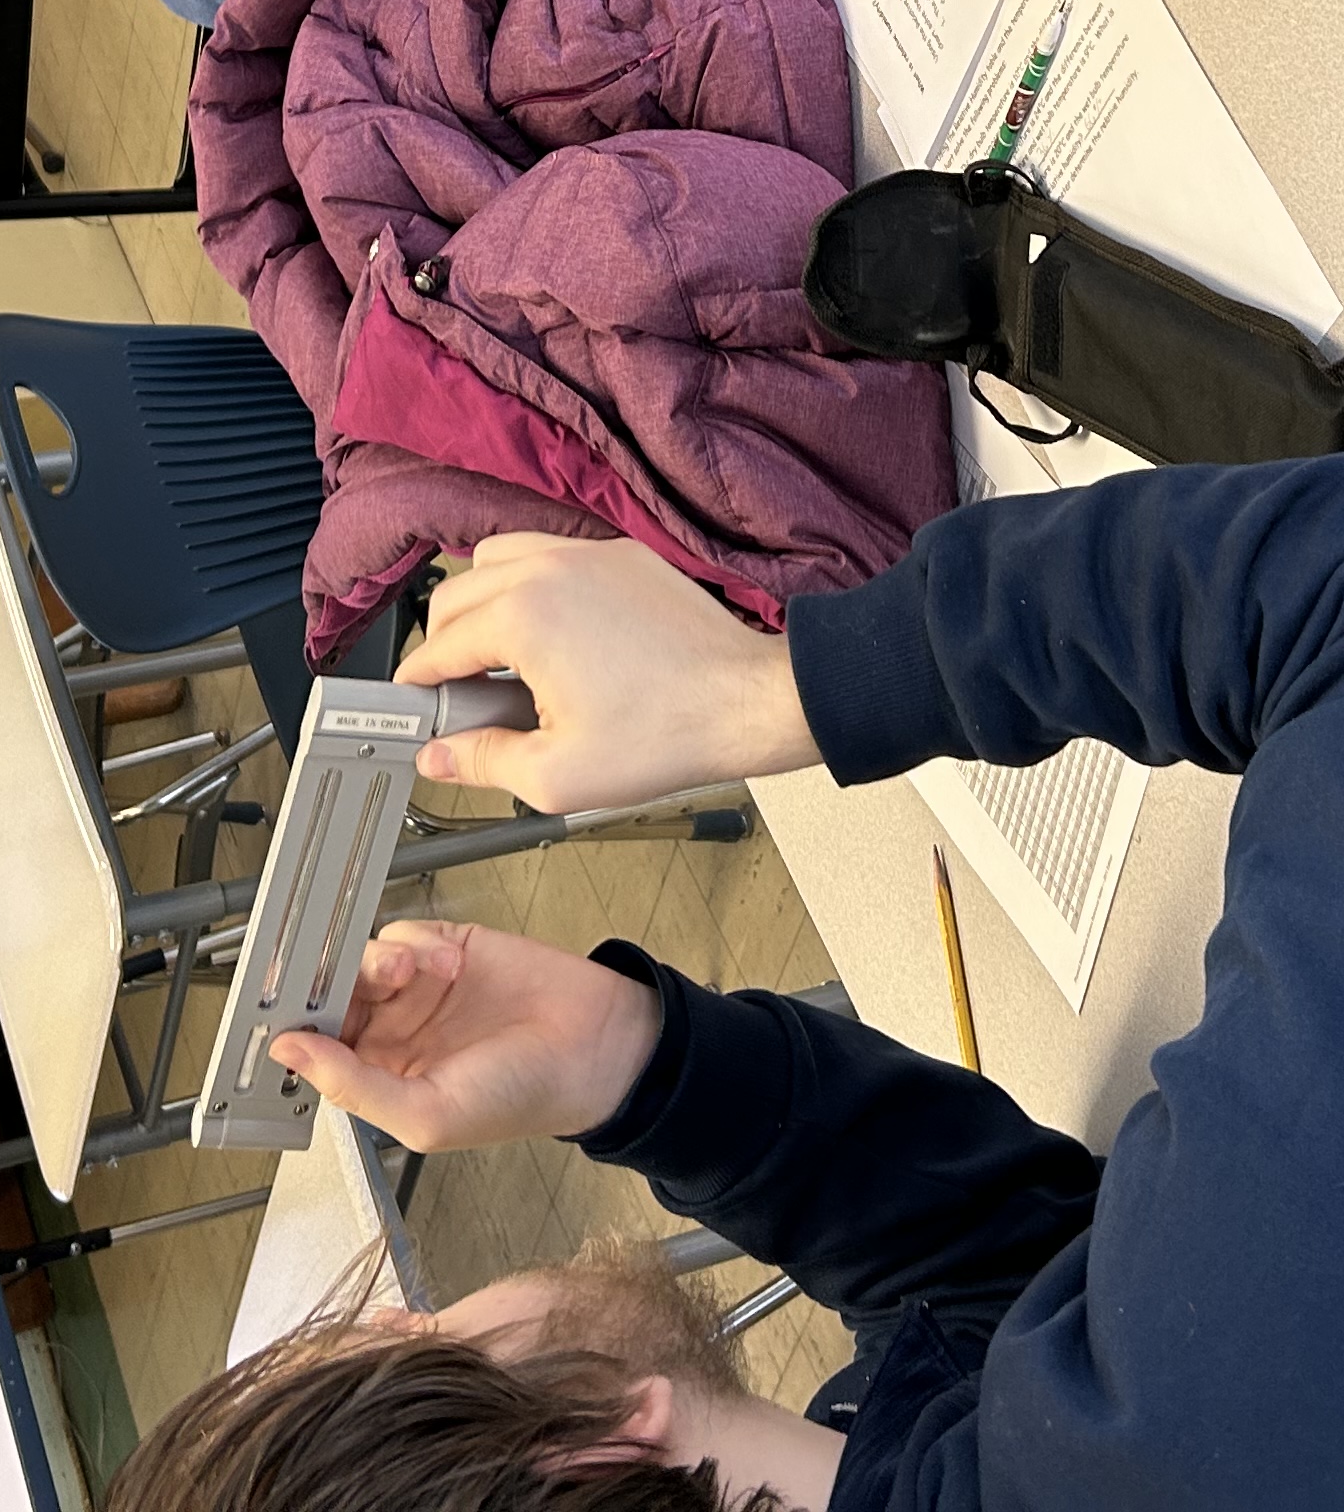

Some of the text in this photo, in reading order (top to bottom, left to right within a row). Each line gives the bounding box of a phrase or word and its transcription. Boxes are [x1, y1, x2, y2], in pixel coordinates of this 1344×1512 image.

[1042, 111, 1054, 128] bulb
[1053, 66, 1080, 111] temperature
[1094, 17, 1108, 39] What
[1044, 86, 1053, 102] and
[1052, 74, 1061, 87] the
[1061, 35, 1084, 74] difference
[1083, 3, 1103, 35] between
[1065, 124, 1074, 141] and
[1073, 113, 1082, 126] the
[1082, 98, 1090, 113] wet
[1089, 82, 1100, 99] bulb
[1100, 35, 1128, 81] temperature
[1070, 146, 1092, 182] determine
[1091, 132, 1101, 146] the
[1100, 104, 1117, 133] relative
